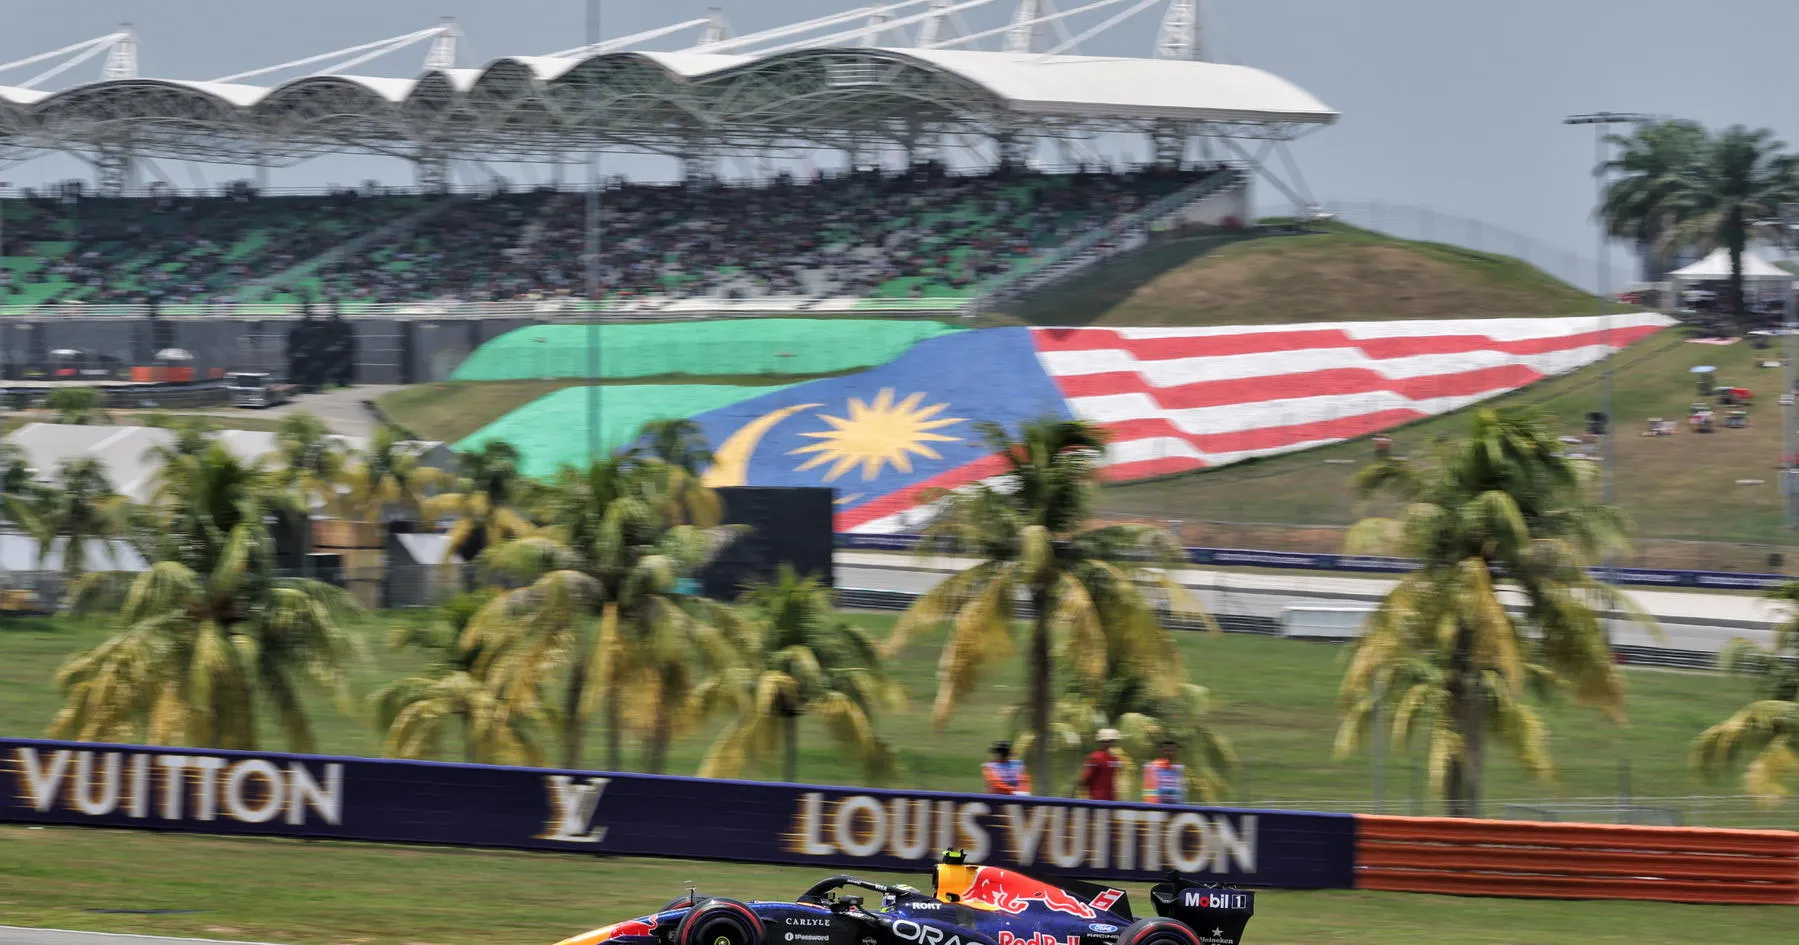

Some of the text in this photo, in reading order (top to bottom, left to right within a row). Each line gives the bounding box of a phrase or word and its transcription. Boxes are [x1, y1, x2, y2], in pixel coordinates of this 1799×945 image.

[16, 746, 344, 826] VUITTON
[796, 792, 1257, 874] LOUIS VUITTON
[912, 902, 942, 910] ROKT
[1184, 892, 1229, 909] Mobil
[785, 917, 831, 927] CARLYLE
[794, 932, 830, 942] 1Password
[892, 919, 985, 945] ORA
[1042, 933, 1081, 945] Bll
[1199, 936, 1234, 945] Heineken
